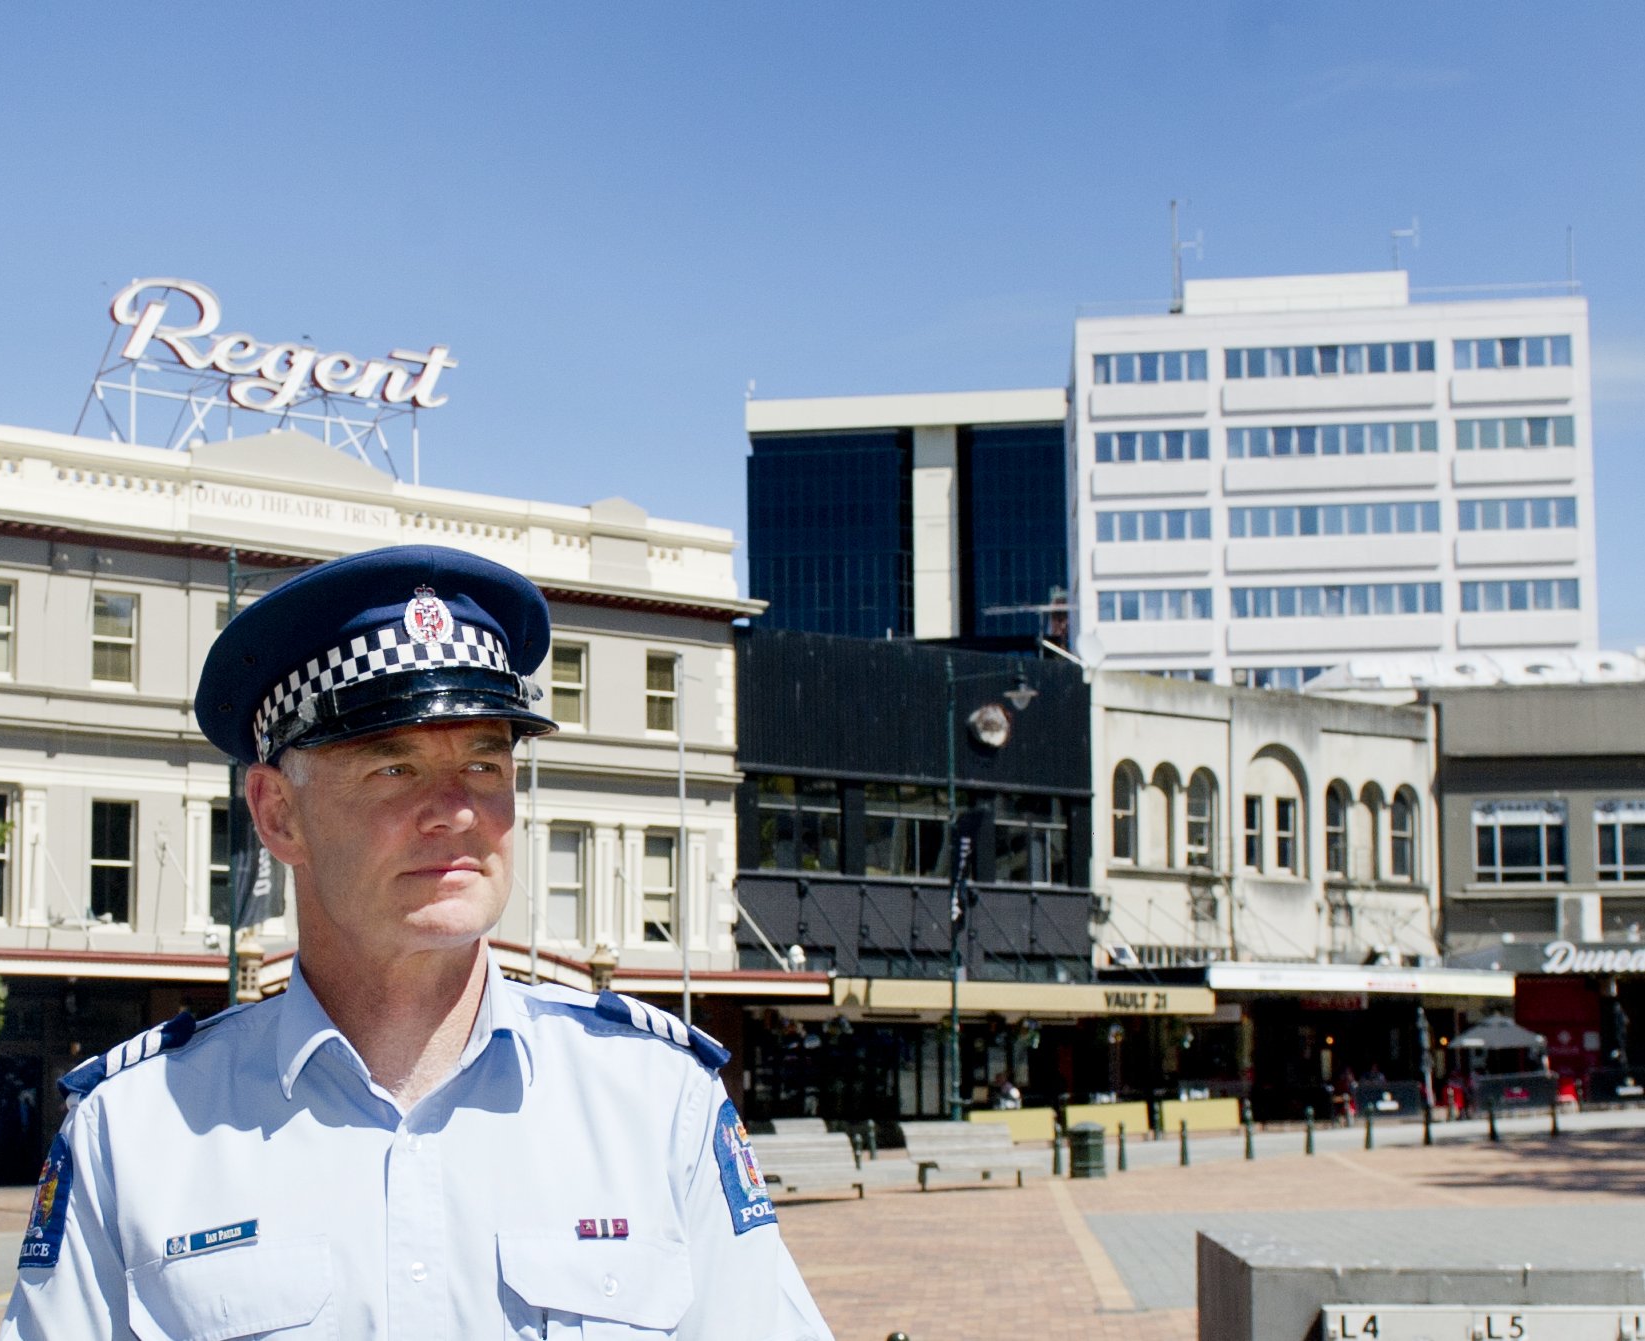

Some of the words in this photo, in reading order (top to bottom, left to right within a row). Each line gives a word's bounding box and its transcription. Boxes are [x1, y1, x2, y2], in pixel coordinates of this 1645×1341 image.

[110, 277, 458, 410] Regent
[195, 485, 253, 509] OTAGO
[260, 494, 337, 520] THEATRE
[342, 505, 390, 528] TRUST
[1103, 991, 1147, 1008] VAULT
[1155, 991, 1167, 1009] 21
